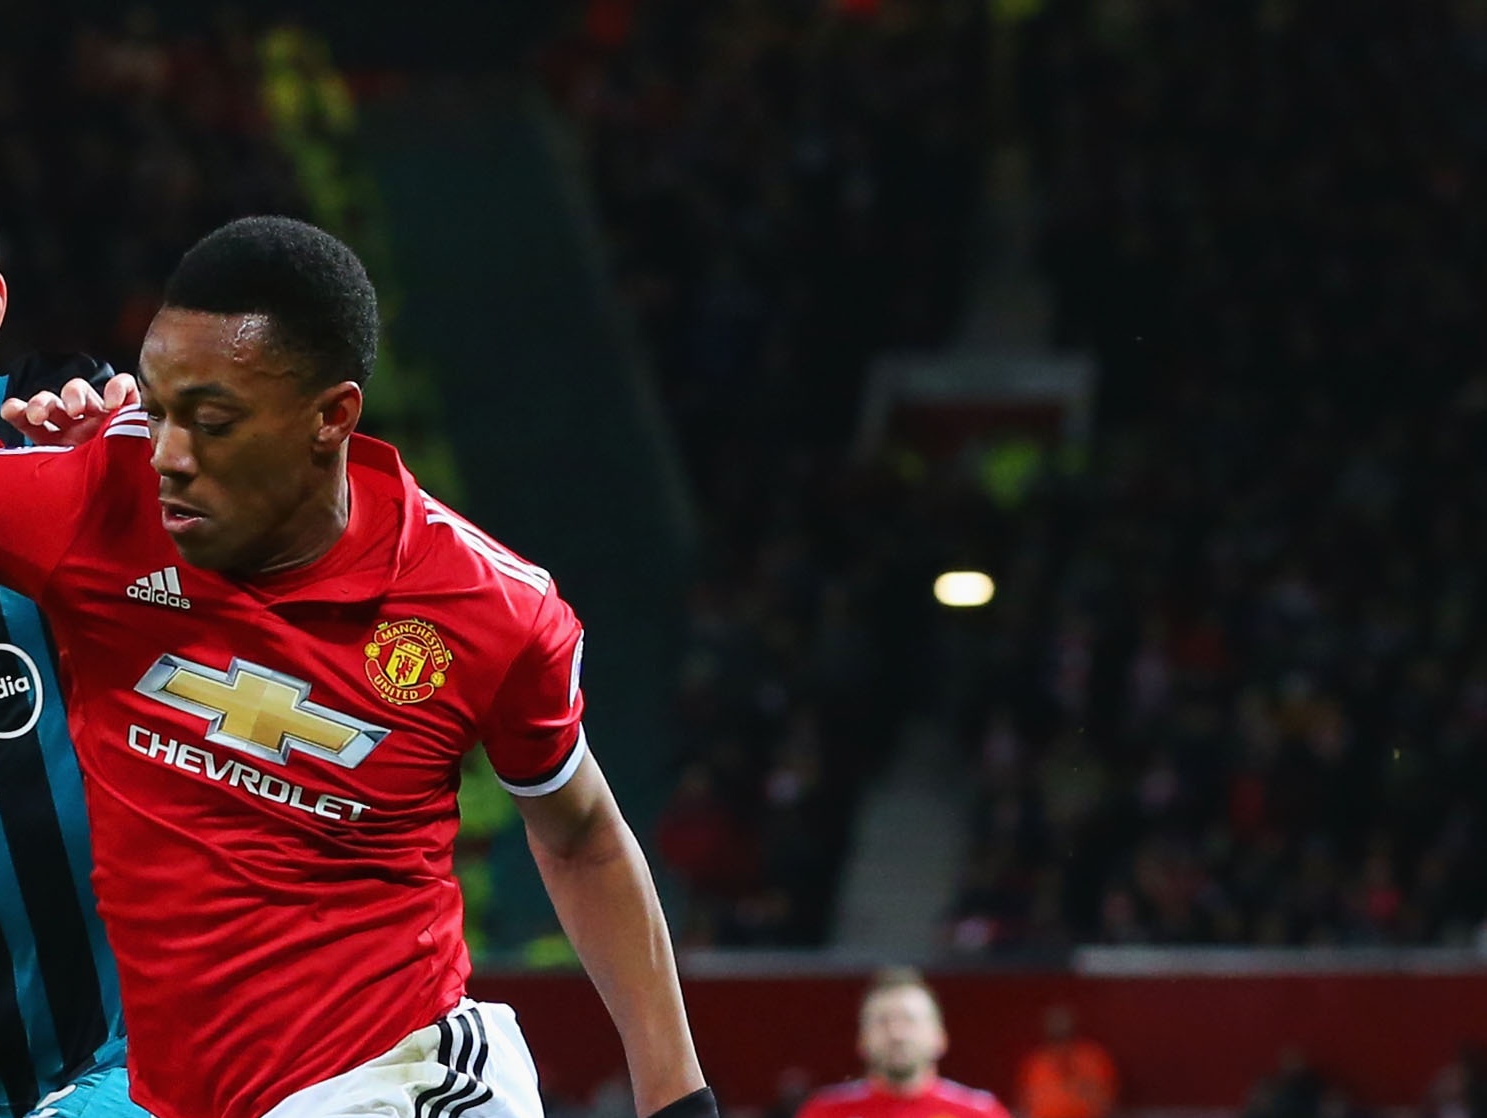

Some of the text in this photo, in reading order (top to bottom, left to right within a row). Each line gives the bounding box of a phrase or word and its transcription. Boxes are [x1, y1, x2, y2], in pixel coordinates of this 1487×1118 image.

[126, 582, 191, 610] adidas
[381, 623, 444, 666] MANCHESTER
[373, 674, 419, 701] UNITED
[127, 724, 371, 822] CHEVROLET
